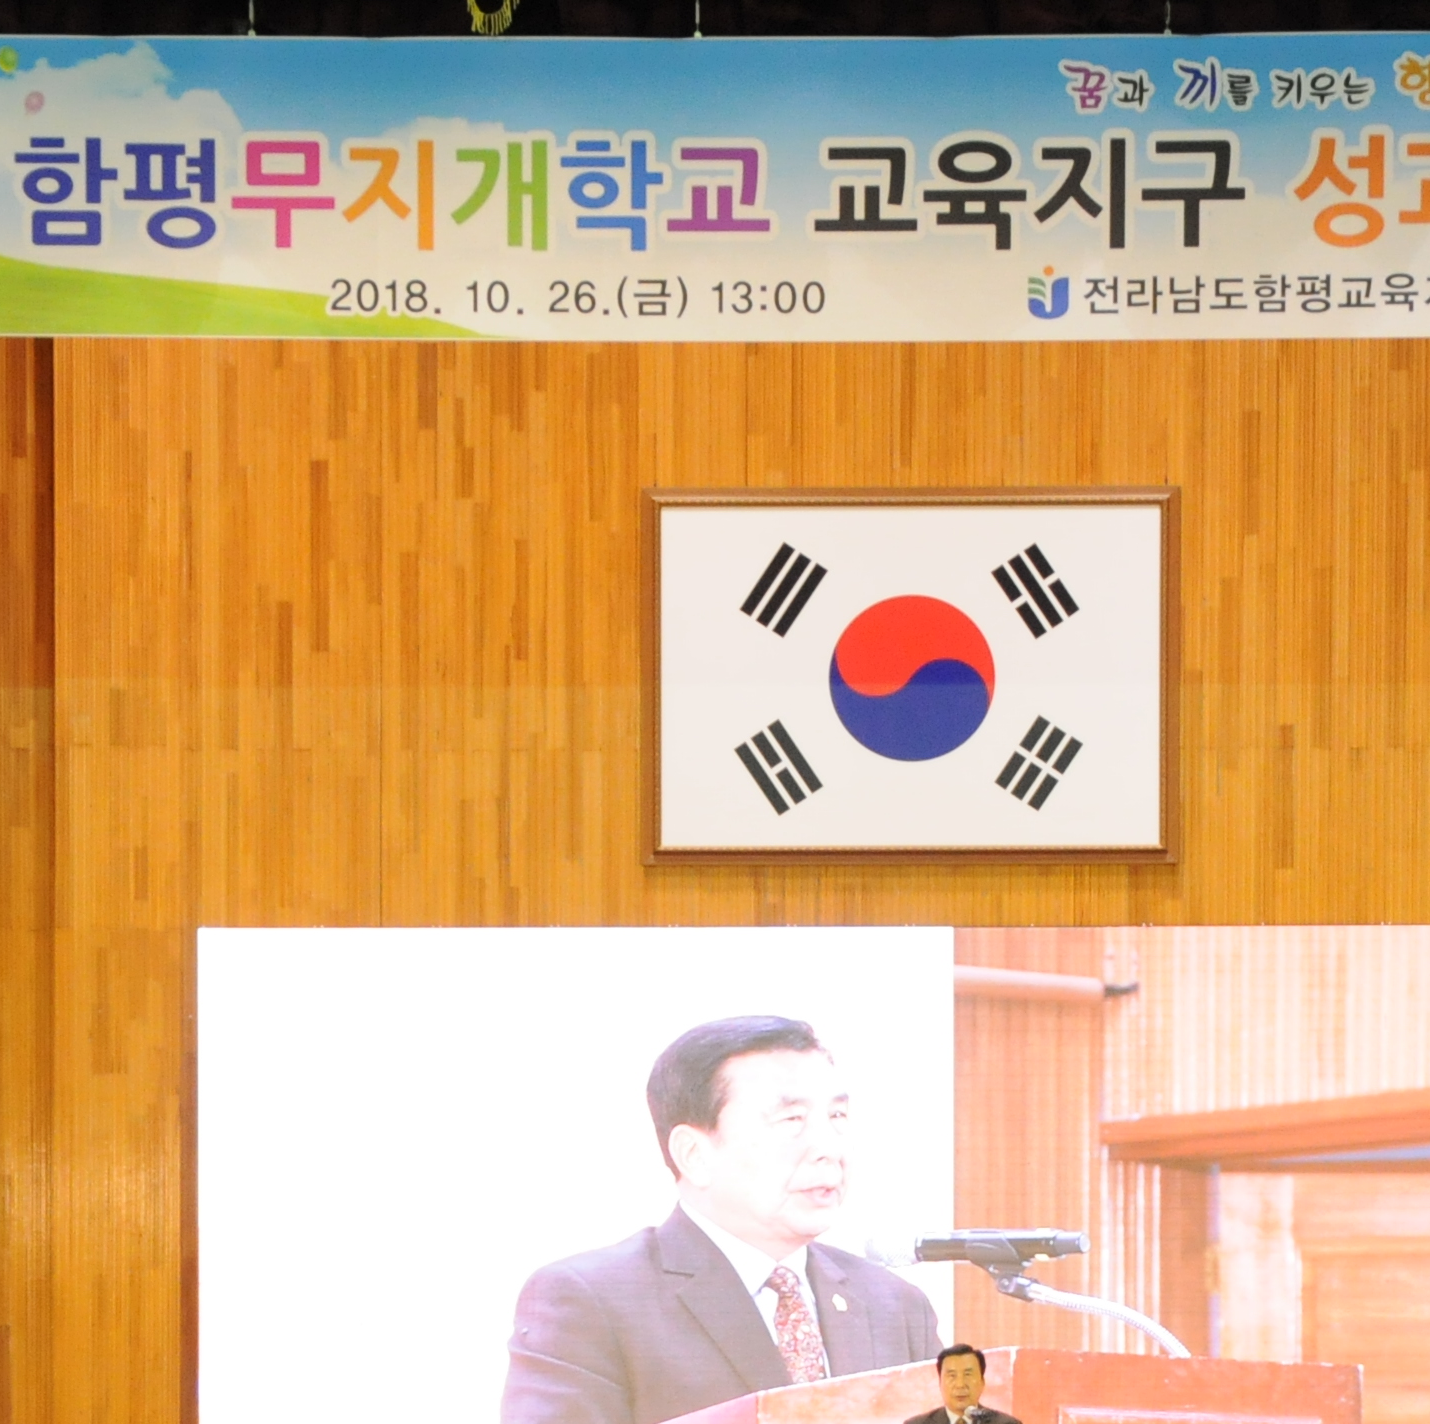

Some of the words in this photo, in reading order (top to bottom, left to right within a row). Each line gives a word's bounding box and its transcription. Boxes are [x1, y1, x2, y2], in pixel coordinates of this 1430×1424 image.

[1063, 64, 1150, 109] 꿈과
[1178, 62, 1252, 106] 끼를
[1274, 72, 1370, 106] 키우는
[14, 136, 771, 252] 함평무지개학교
[813, 138, 1246, 250] 교육지구
[330, 279, 442, 314] 2018.
[466, 281, 525, 315] 10.
[548, 275, 689, 319] 26.(금)
[710, 281, 826, 315] 13:00
